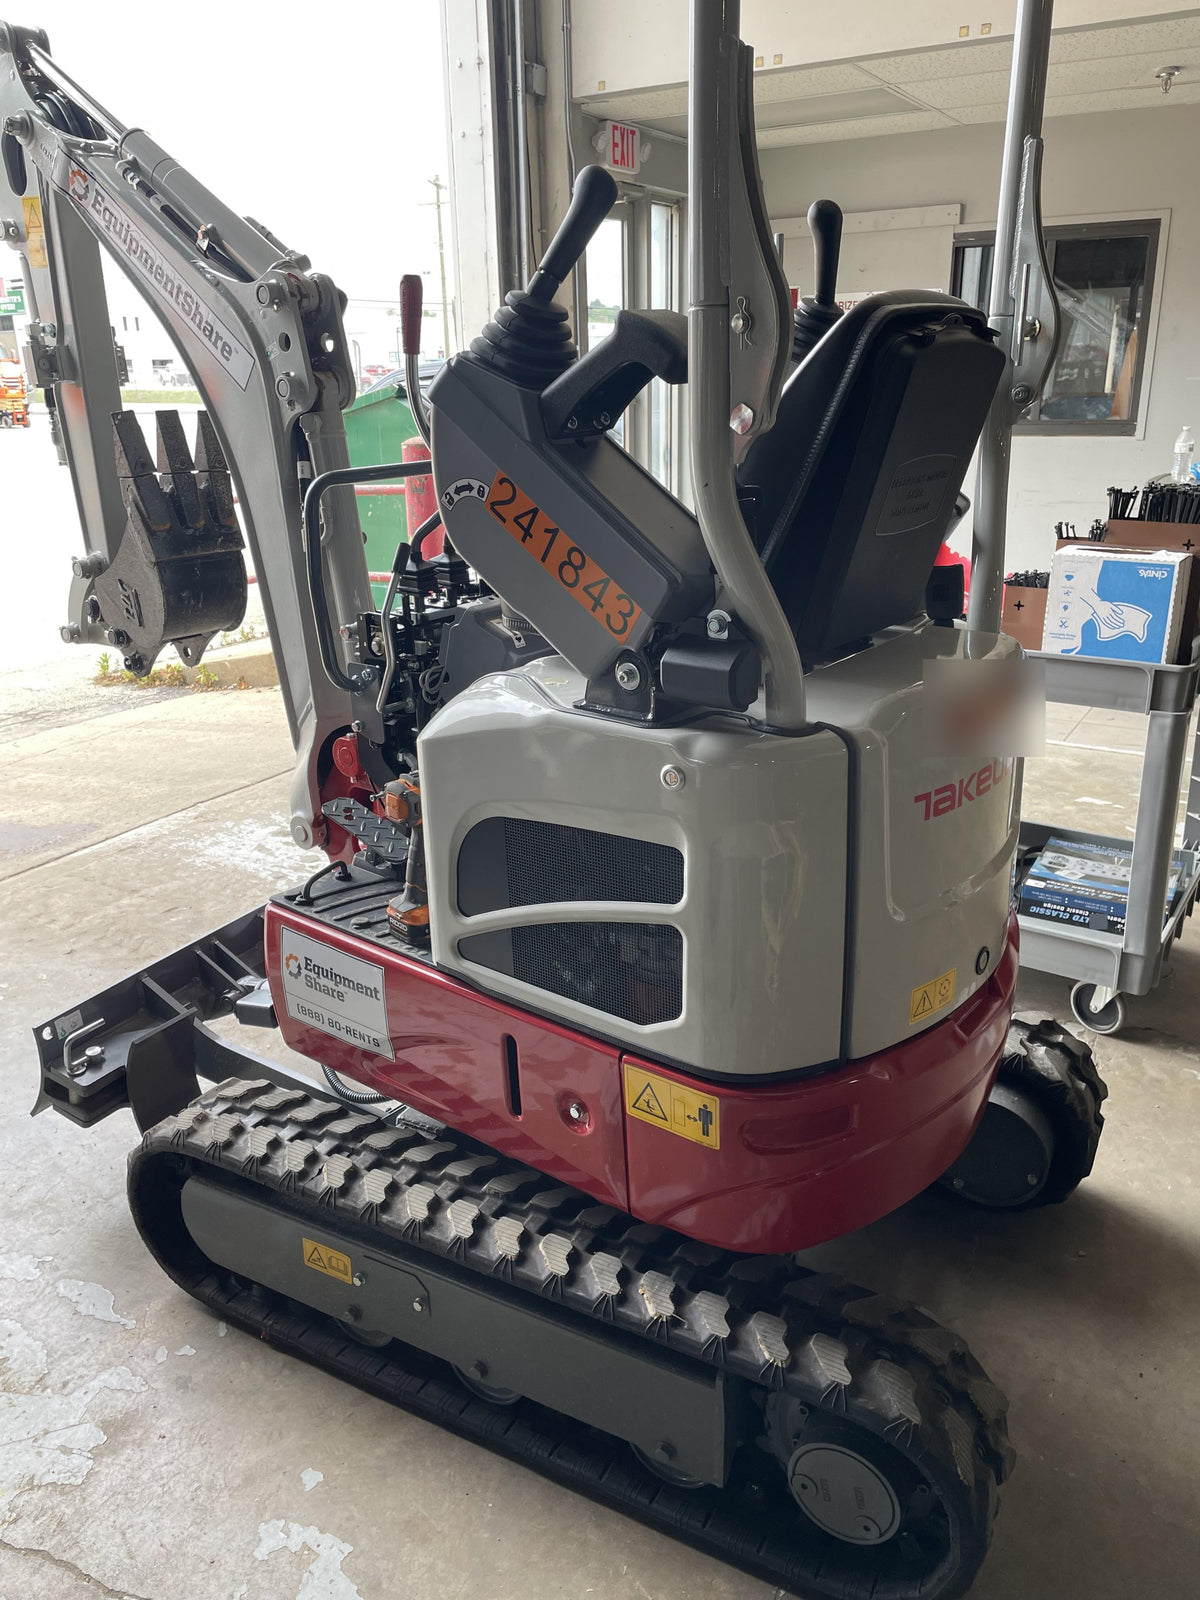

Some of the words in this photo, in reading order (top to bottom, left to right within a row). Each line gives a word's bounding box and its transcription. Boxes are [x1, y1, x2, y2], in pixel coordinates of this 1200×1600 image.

[611, 124, 637, 169] EXIT
[489, 476, 635, 636] 241843
[1029, 905, 1069, 920] CLASSIC
[1072, 914, 1090, 924] LTD
[304, 956, 380, 1001] Equipment
[304, 974, 345, 1002] Share
[296, 1003, 325, 1024] (888)
[327, 1017, 381, 1047] 80-RENTS
